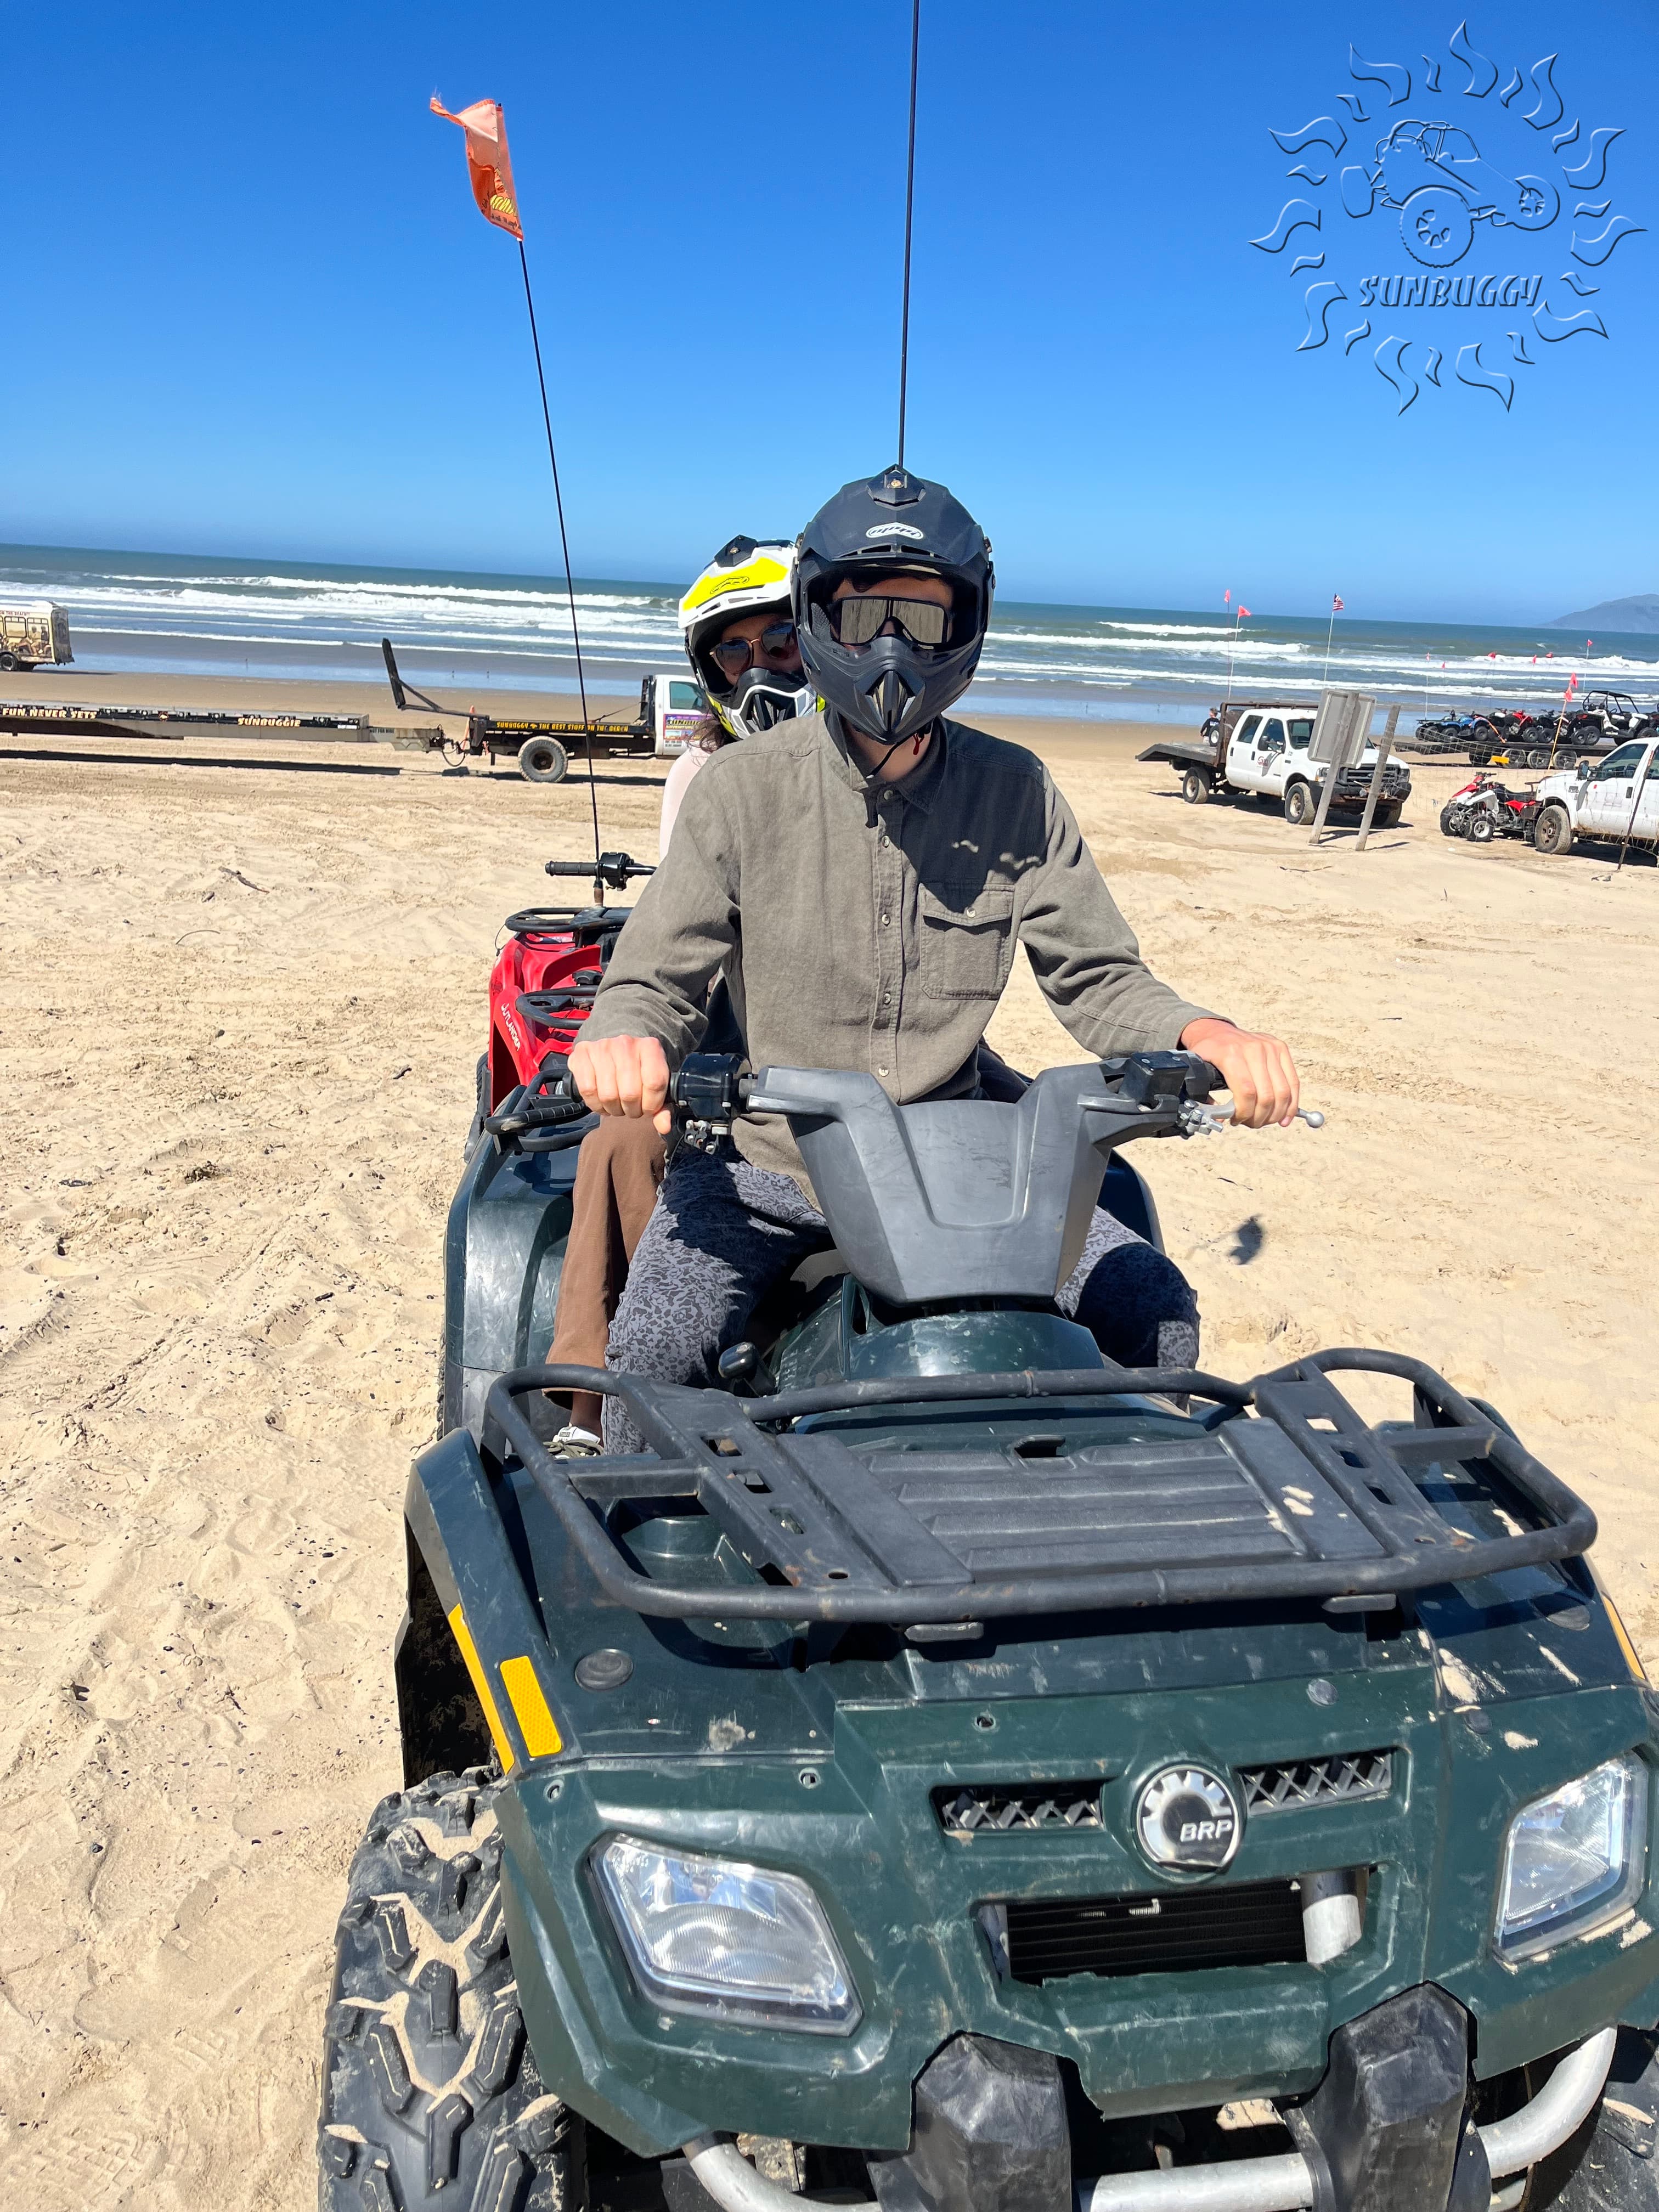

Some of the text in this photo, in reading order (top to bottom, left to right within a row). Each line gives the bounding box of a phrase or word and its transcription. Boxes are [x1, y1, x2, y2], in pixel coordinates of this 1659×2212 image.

[29, 709, 67, 718] NEVER
[71, 710, 97, 719] SETS
[238, 717, 301, 727] SUNBUGGIE
[1180, 1819, 1233, 1842] BRP
